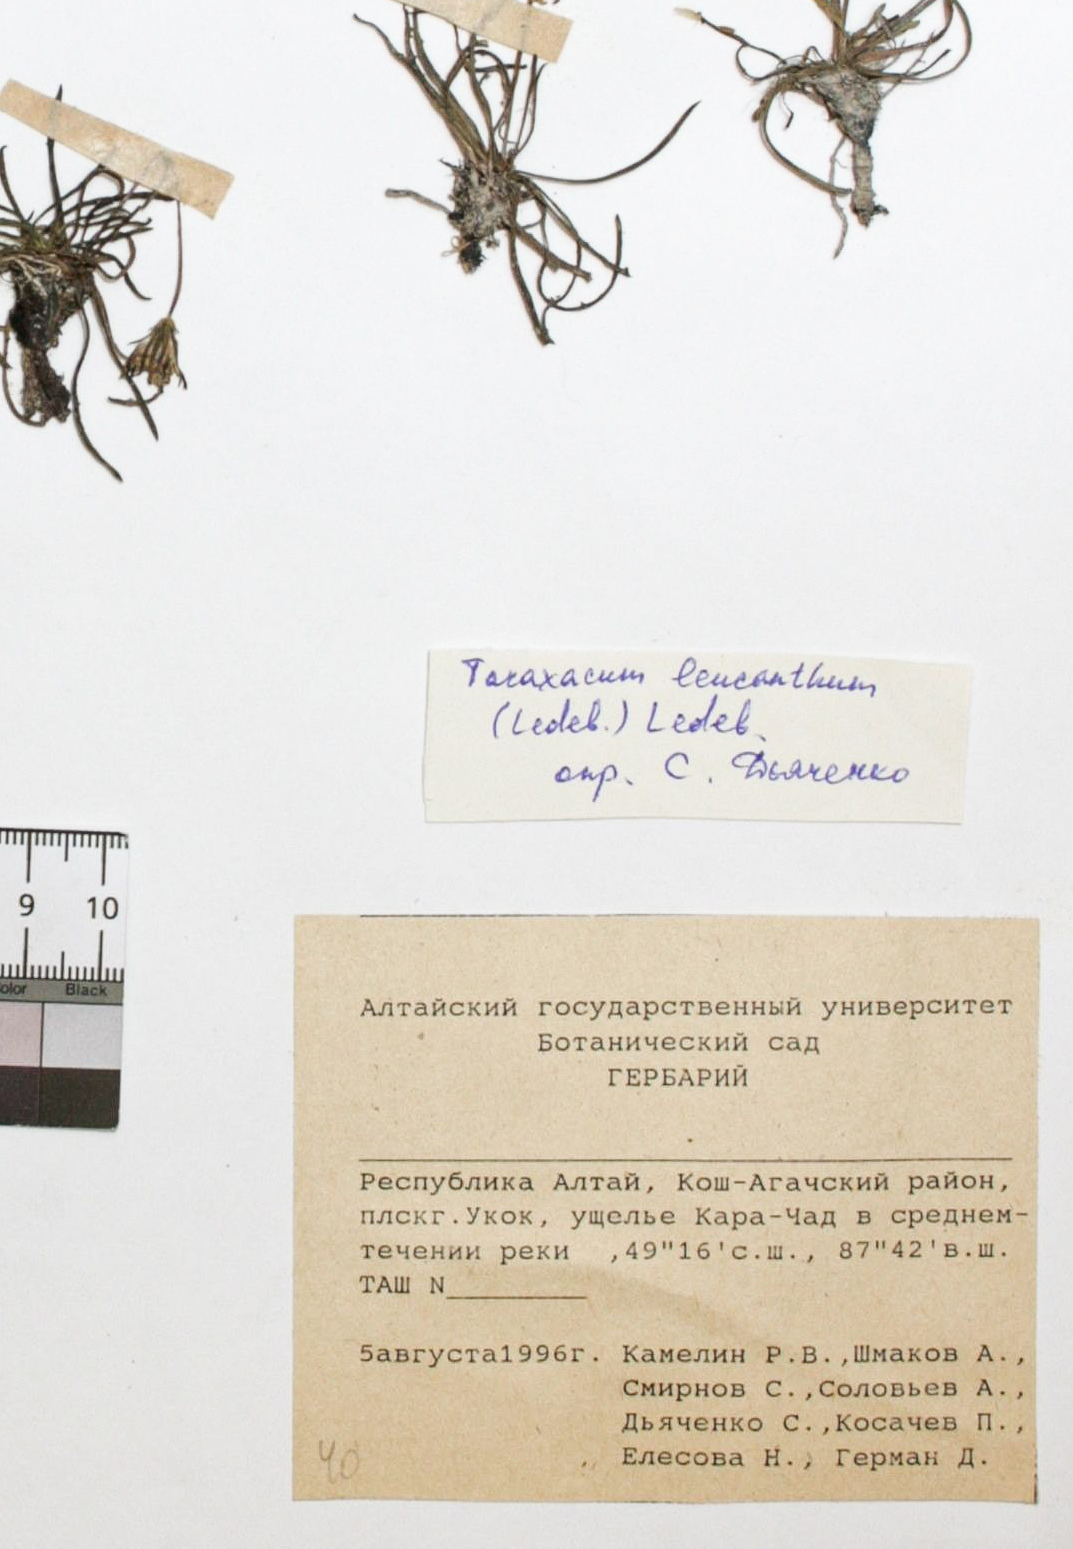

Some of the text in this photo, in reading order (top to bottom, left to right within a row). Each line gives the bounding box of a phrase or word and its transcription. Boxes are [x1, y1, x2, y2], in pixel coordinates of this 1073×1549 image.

[19, 893, 35, 917] 9
[87, 896, 119, 920] 10
[65, 983, 108, 997] Black
[360, 997, 1013, 1021] Алтайский государственный университет
[537, 1032, 820, 1055] Ботанический сад
[608, 1064, 749, 1087] ГЕРБАРИЙ
[360, 1171, 1010, 1195] Республика Алтай, Кош-Агачский район,
[571, 1209, 676, 1230] ущелье
[695, 1207, 837, 1230] Кара-Чад
[857, 1210, 872, 1225] в
[890, 1207, 1029, 1228] среднем-
[360, 1243, 481, 1261] течении
[500, 1243, 570, 1265] реки
[359, 1276, 410, 1295] ТАШ
[360, 1344, 600, 1368] 5августа1996г.
[622, 1344, 746, 1364] Камелин
[977, 1343, 1025, 1366] А.,
[622, 1378, 746, 1401] Смирнов
[977, 1378, 1025, 1400] А.,
[622, 1412, 764, 1433] Дьяченко
[977, 1412, 1025, 1435] П.,
[622, 1447, 988, 1471] Елесова Н., Герман Д.
